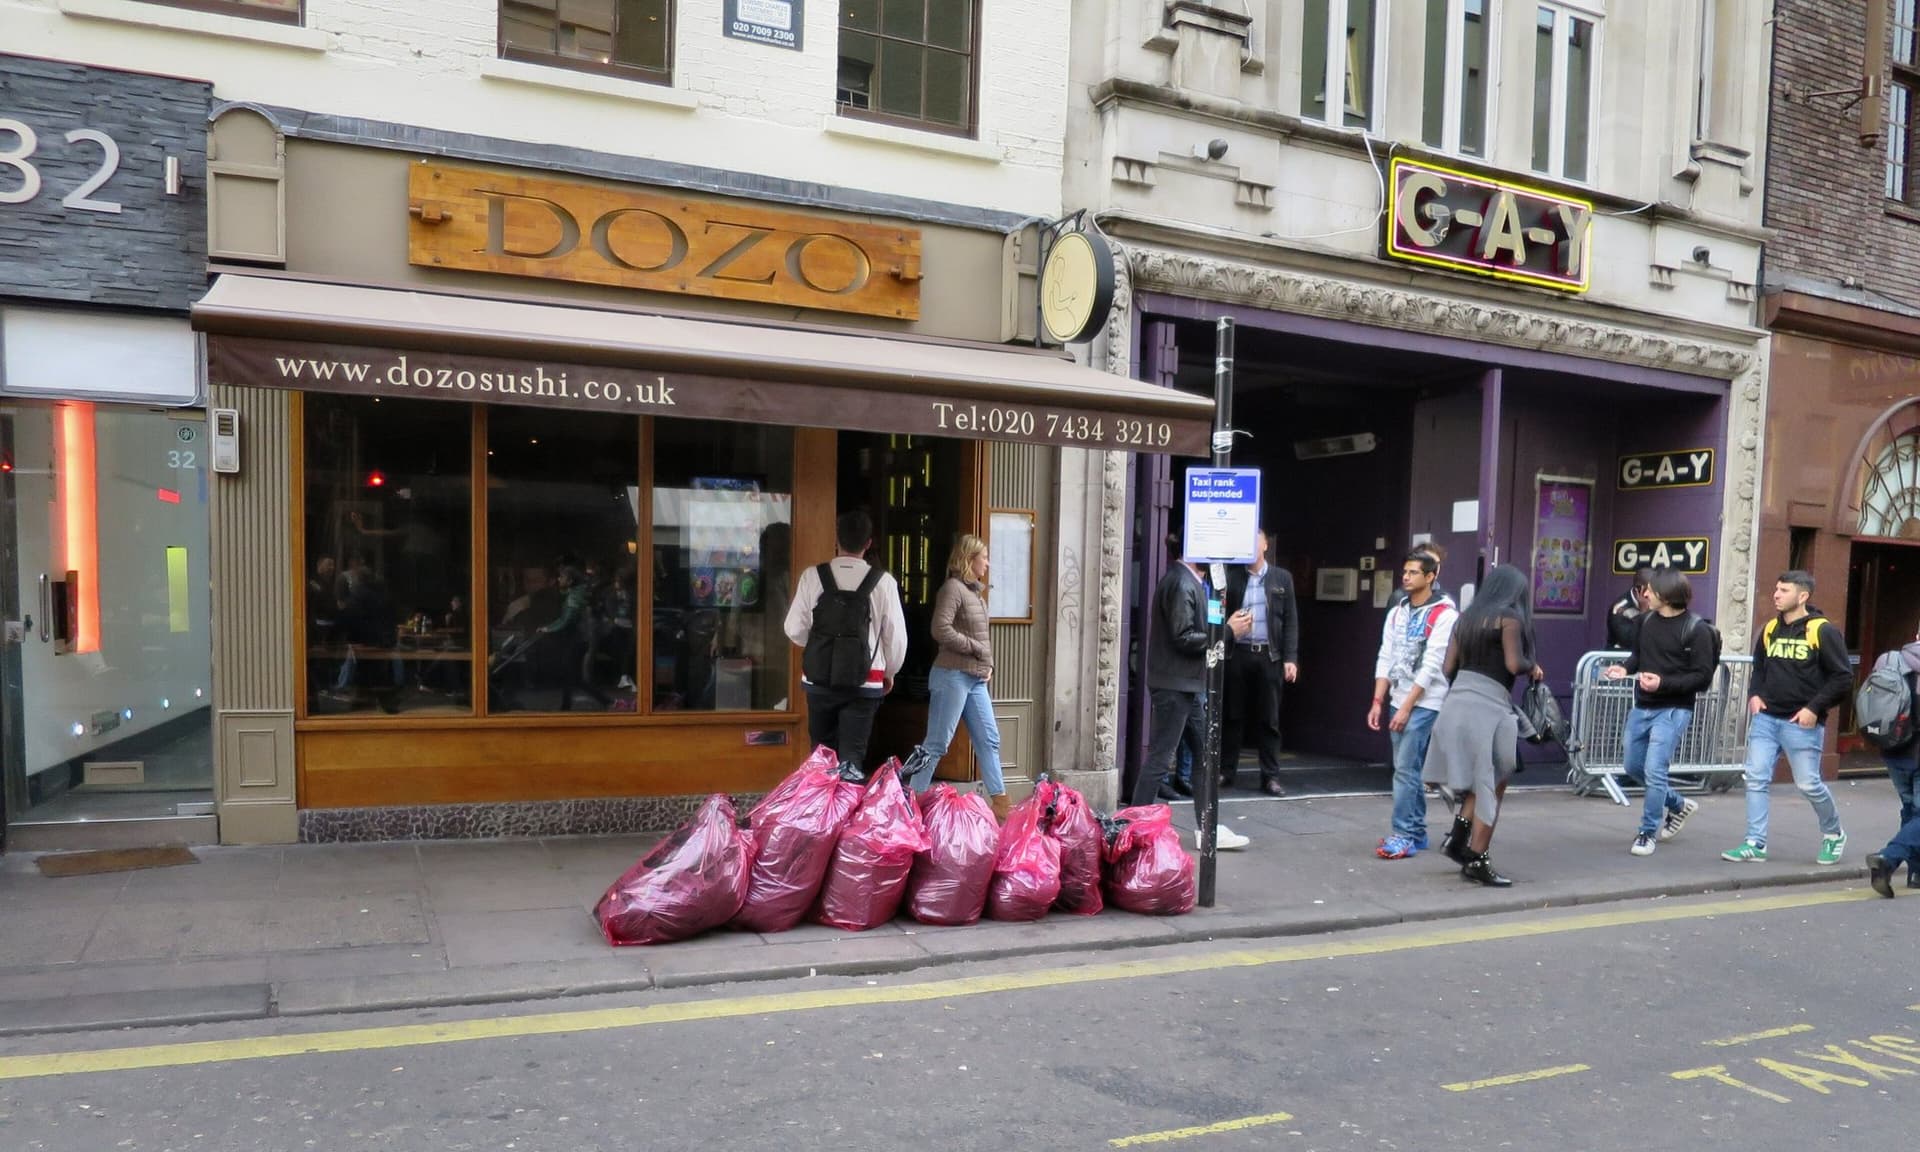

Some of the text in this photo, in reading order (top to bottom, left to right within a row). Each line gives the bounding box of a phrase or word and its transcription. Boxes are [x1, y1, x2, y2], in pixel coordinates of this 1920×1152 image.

[733, 22, 795, 41] 020 7009 2300
[1399, 172, 1592, 276] G-A-Y
[472, 188, 872, 297] DOZO
[275, 356, 677, 406] www.dozosushi.co.uk
[1046, 414, 1105, 441] 7434
[1115, 419, 1172, 446] 3219
[167, 450, 196, 469] 32
[1622, 452, 1709, 485] G-A-Y
[1191, 489, 1243, 501] suspended
[1192, 477, 1235, 487] Taxi rank
[1618, 541, 1704, 569] G-A-Y
[1766, 638, 1809, 660] VANS
